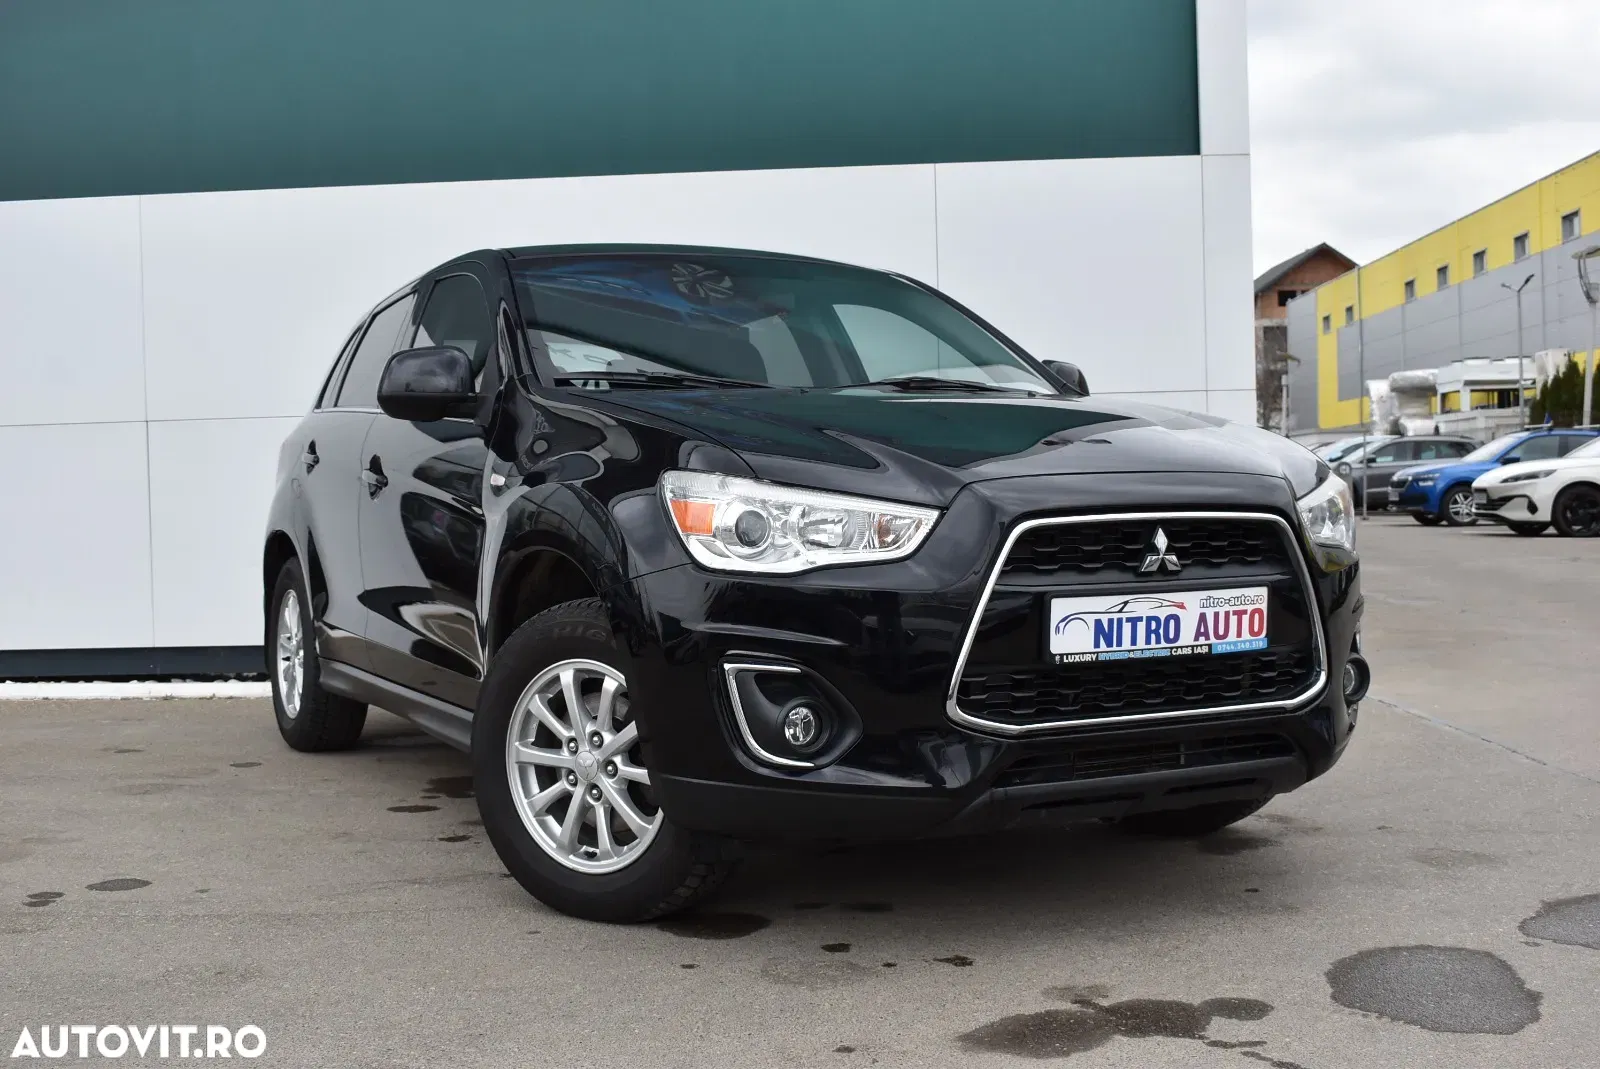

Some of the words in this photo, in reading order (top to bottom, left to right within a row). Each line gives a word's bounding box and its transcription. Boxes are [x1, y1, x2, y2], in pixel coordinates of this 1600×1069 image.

[1199, 594, 1265, 608] nitro-auto.ro
[1093, 613, 1181, 649] NITRO
[1193, 607, 1265, 642] AUTO
[1063, 653, 1097, 663] LUXURY
[1171, 647, 1192, 656] CARS
